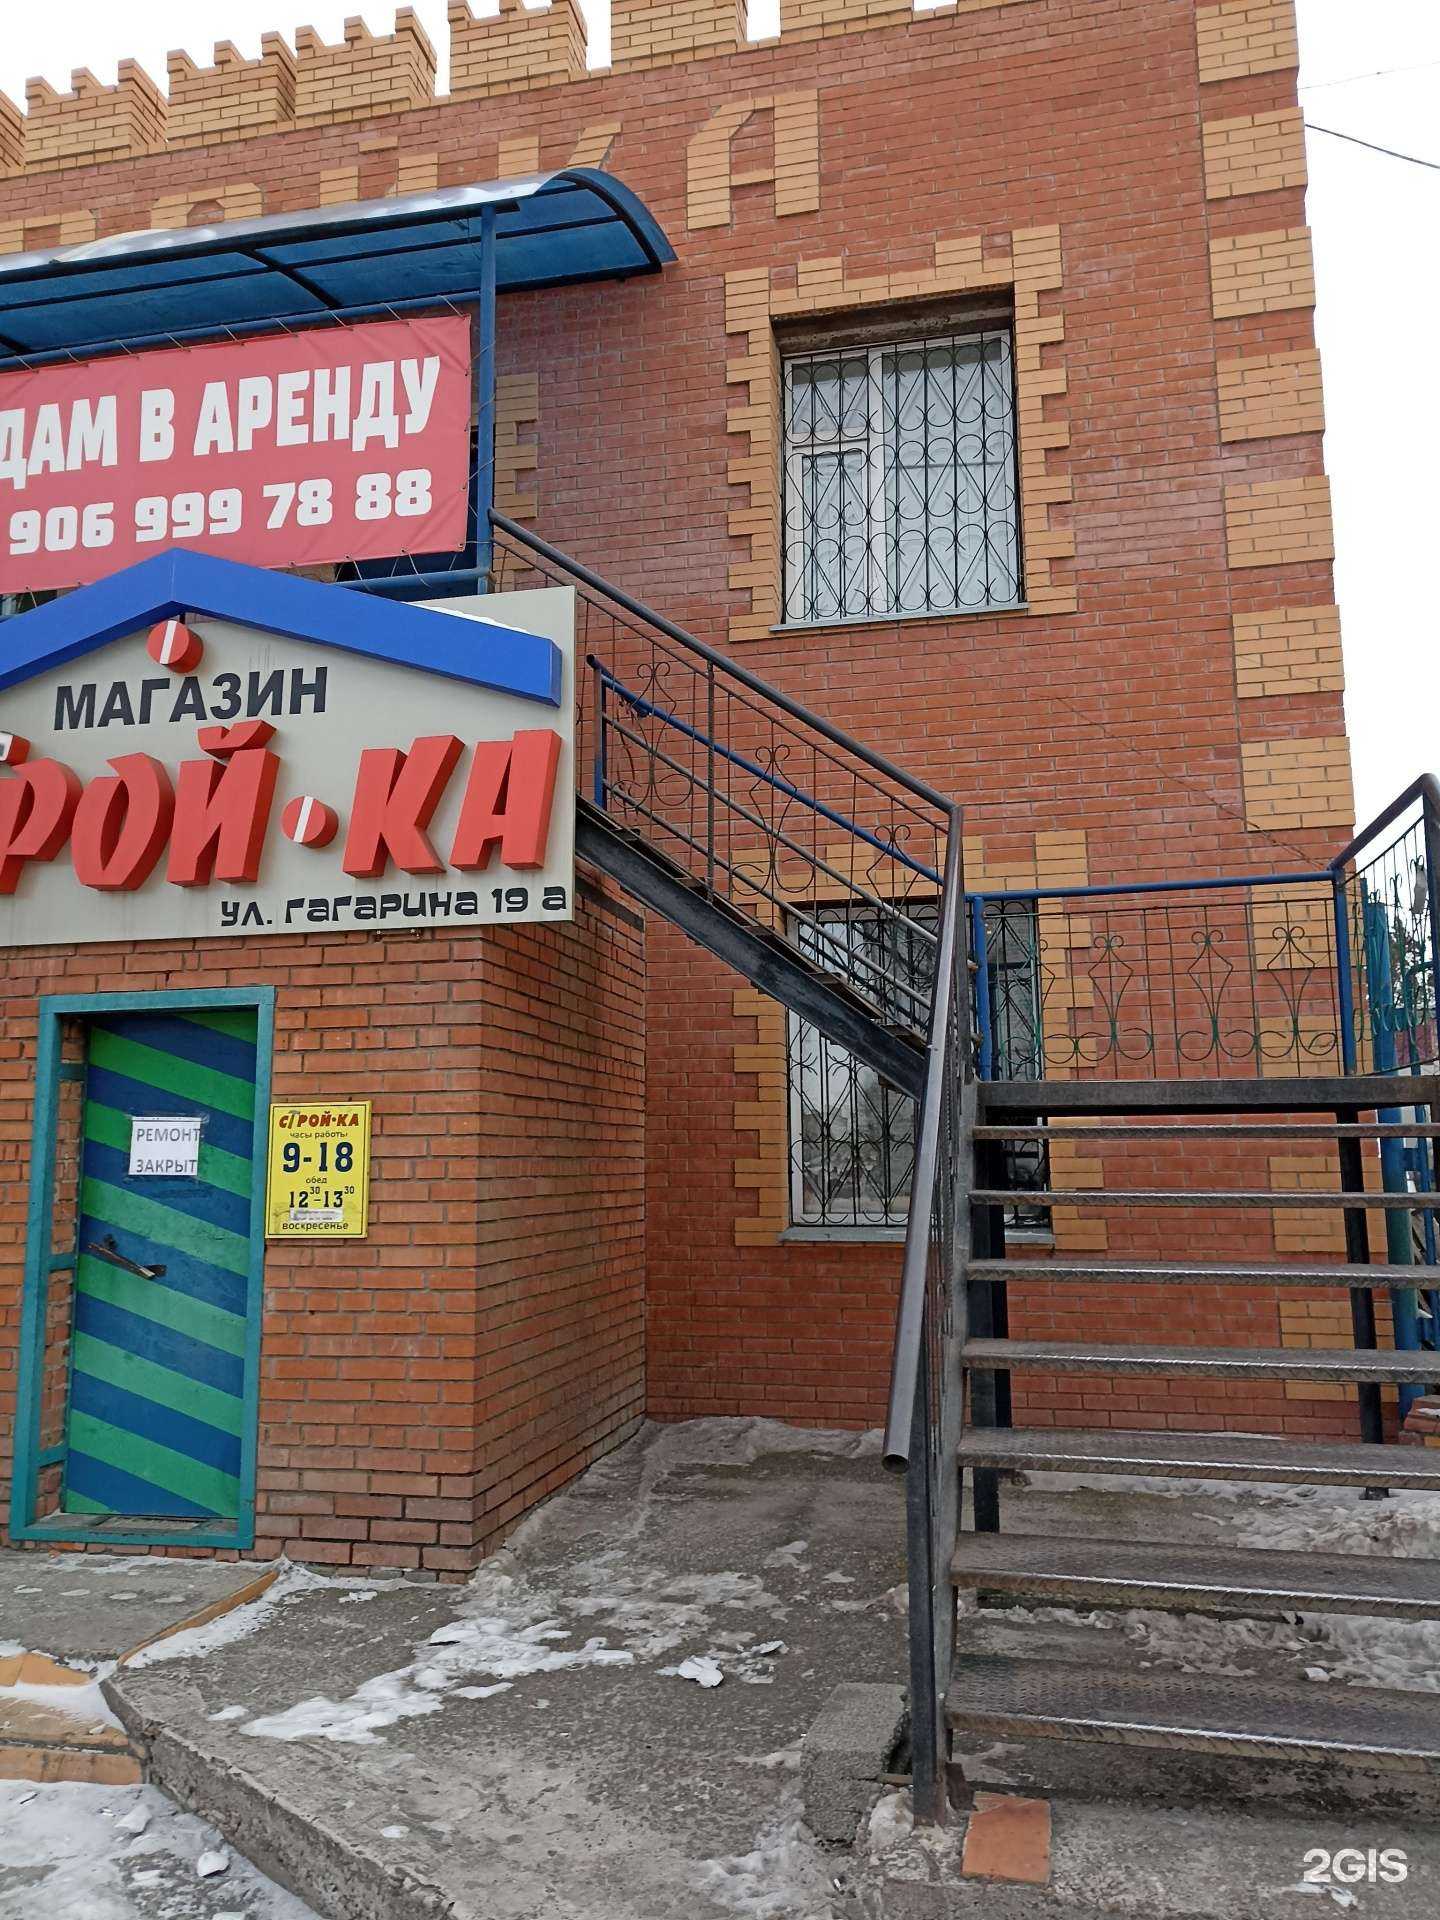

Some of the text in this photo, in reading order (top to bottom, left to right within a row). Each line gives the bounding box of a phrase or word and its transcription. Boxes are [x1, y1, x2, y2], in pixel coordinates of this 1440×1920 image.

[139, 388, 175, 462] В
[193, 355, 441, 456] АРЕНДУ
[9, 468, 432, 556] 906 999 78 88
[54, 667, 327, 731] МАГАЗИН
[221, 900, 273, 927] ул.
[491, 887, 529, 914] 19
[136, 1128, 201, 1142] РЕМОНТ
[289, 1130, 348, 1140] часы работы
[136, 1159, 198, 1173] ЗАКРЫТ
[305, 1175, 328, 1185] обед
[282, 1222, 349, 1232] воскресенье
